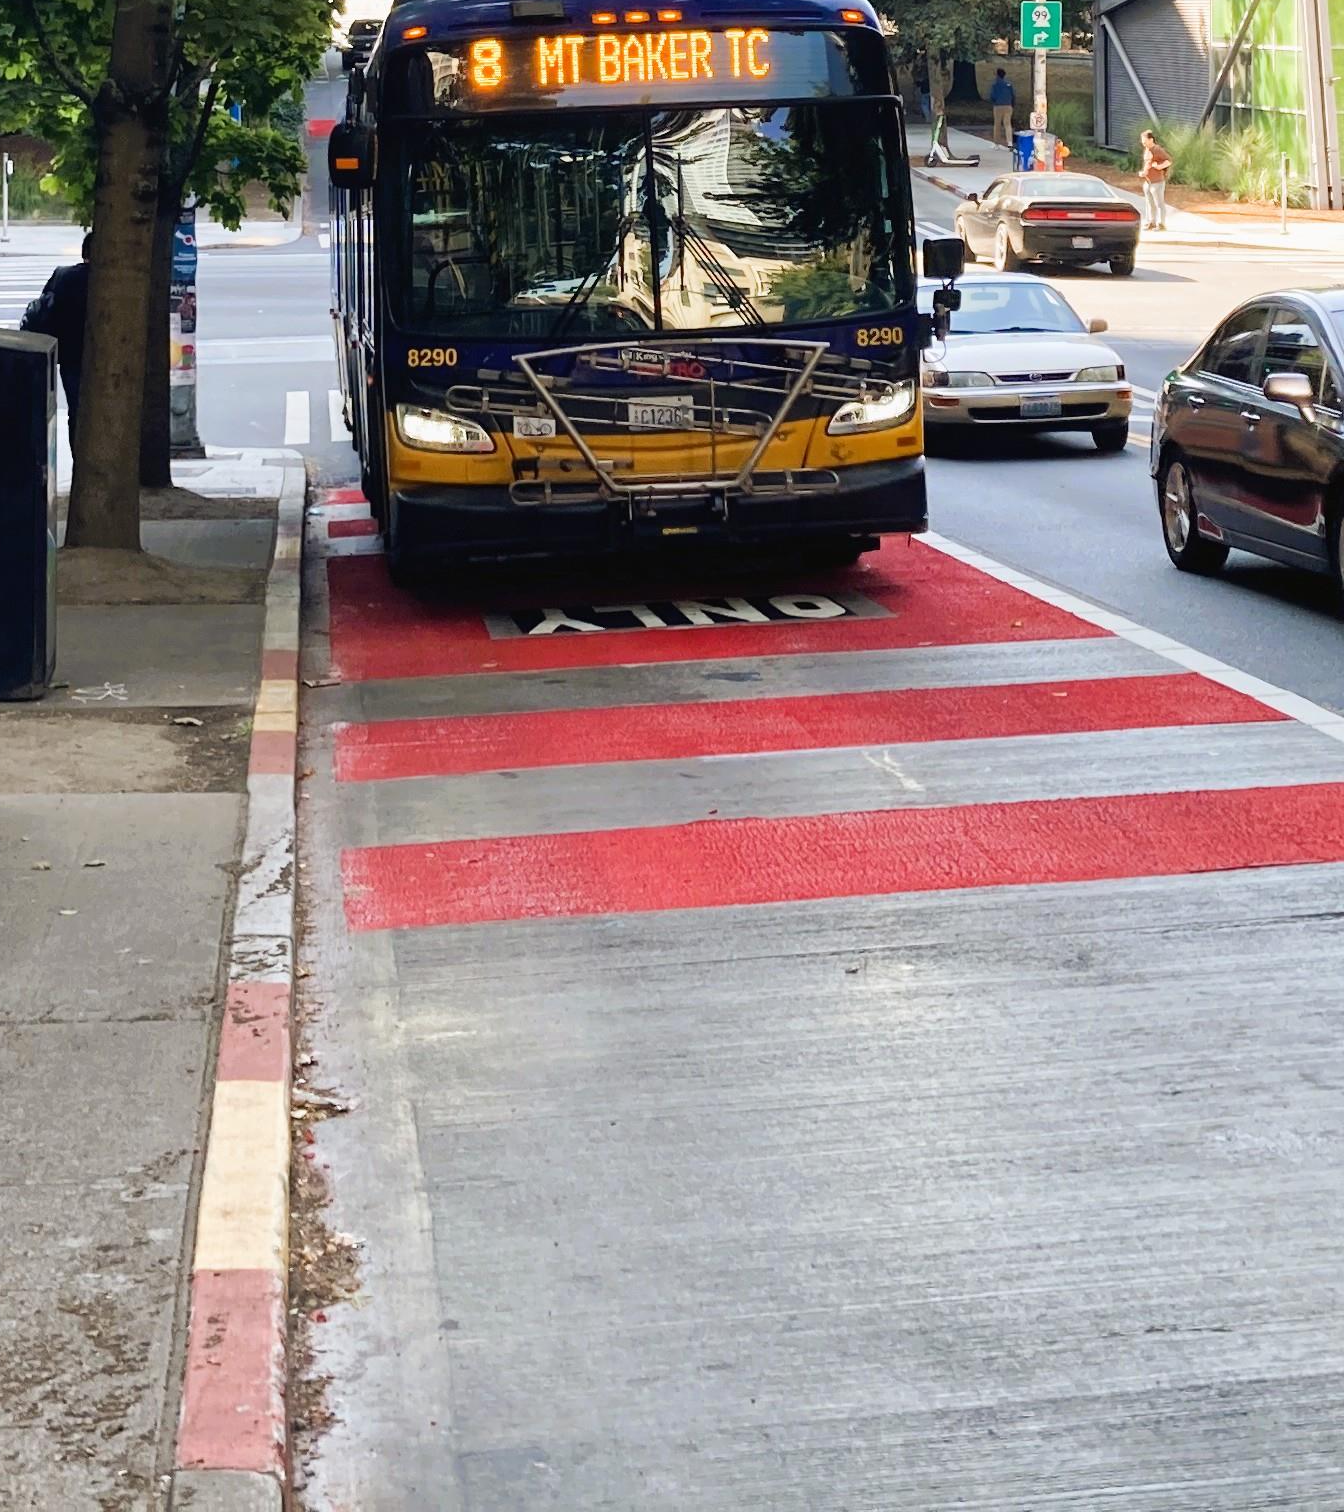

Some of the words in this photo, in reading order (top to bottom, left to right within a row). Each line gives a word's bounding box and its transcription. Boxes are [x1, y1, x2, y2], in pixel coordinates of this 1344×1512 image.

[1034, 11, 1048, 20] 99
[472, 39, 502, 87] 8
[539, 36, 584, 85] MT
[600, 31, 714, 82] BAKER
[725, 29, 771, 77] TC
[856, 327, 903, 347] 8290
[407, 348, 458, 367] 8290
[528, 594, 846, 635] ONLY
